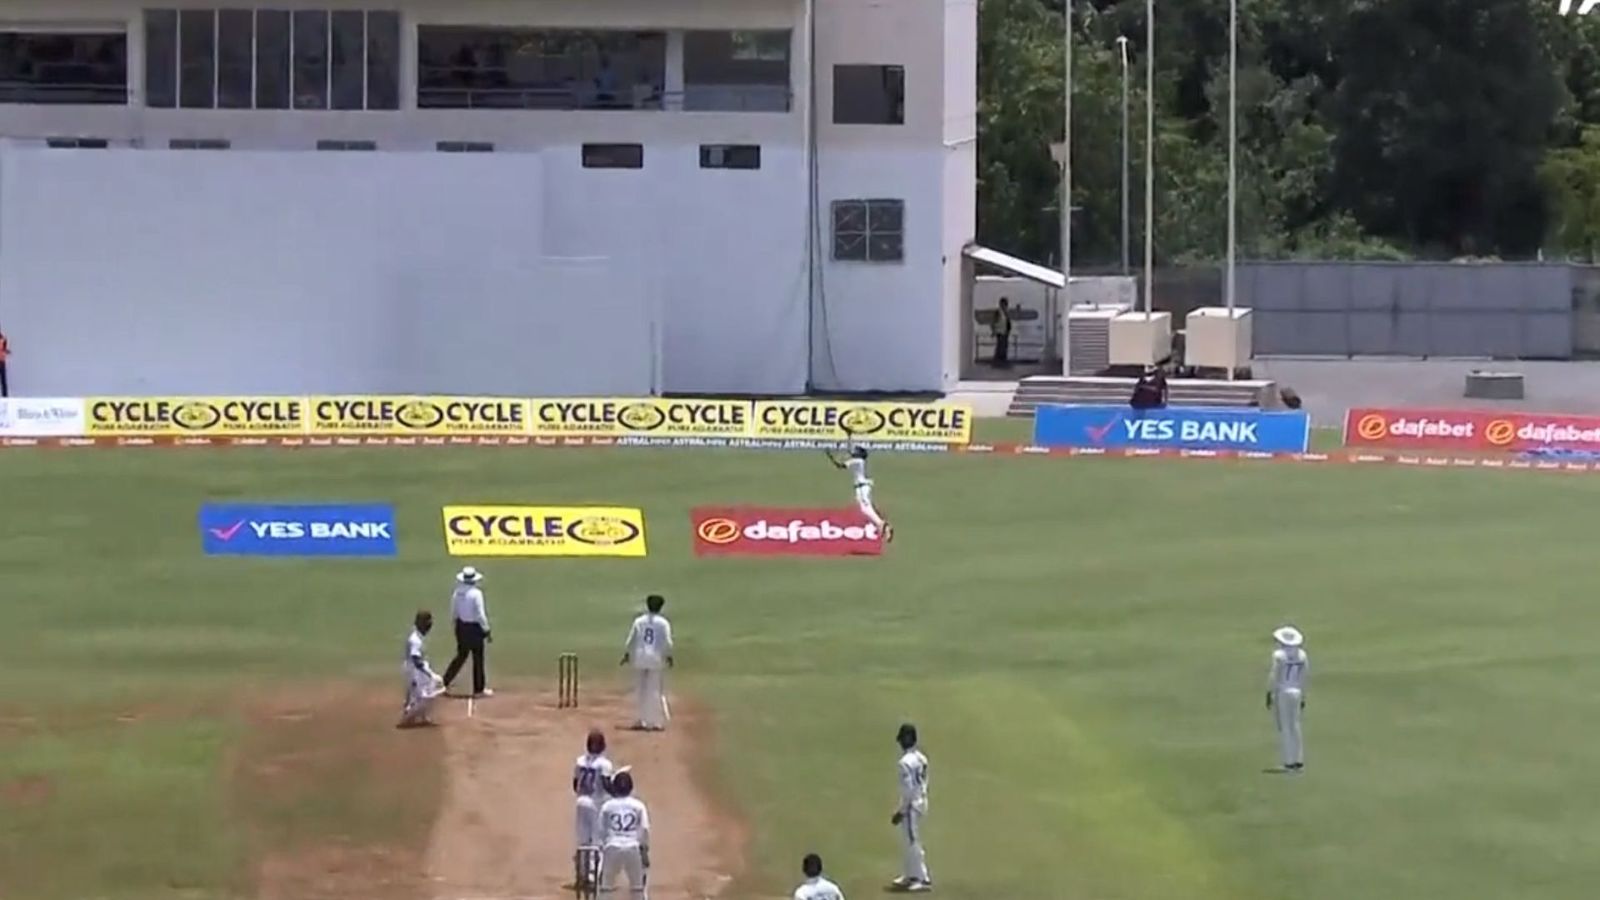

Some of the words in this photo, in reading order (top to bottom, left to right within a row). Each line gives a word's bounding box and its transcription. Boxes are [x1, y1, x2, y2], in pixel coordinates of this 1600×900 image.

[92, 401, 171, 422] CYCLE
[223, 401, 301, 422] CYCLE
[316, 401, 394, 421] CYCLE
[446, 402, 523, 422] CYCLE
[539, 403, 616, 423] CYCLE
[668, 404, 745, 425] CYCLE
[762, 406, 837, 426] CYCLE
[888, 408, 965, 429] CYCLE
[1123, 419, 1174, 441] YES
[1180, 421, 1258, 443] BANK
[1390, 418, 1474, 438] dafabet
[250, 521, 304, 539] YES
[311, 521, 391, 540] BANK
[449, 515, 564, 537] CYCLE
[743, 520, 878, 543] dafabet
[643, 627, 654, 646] 8
[610, 813, 637, 832] 32
